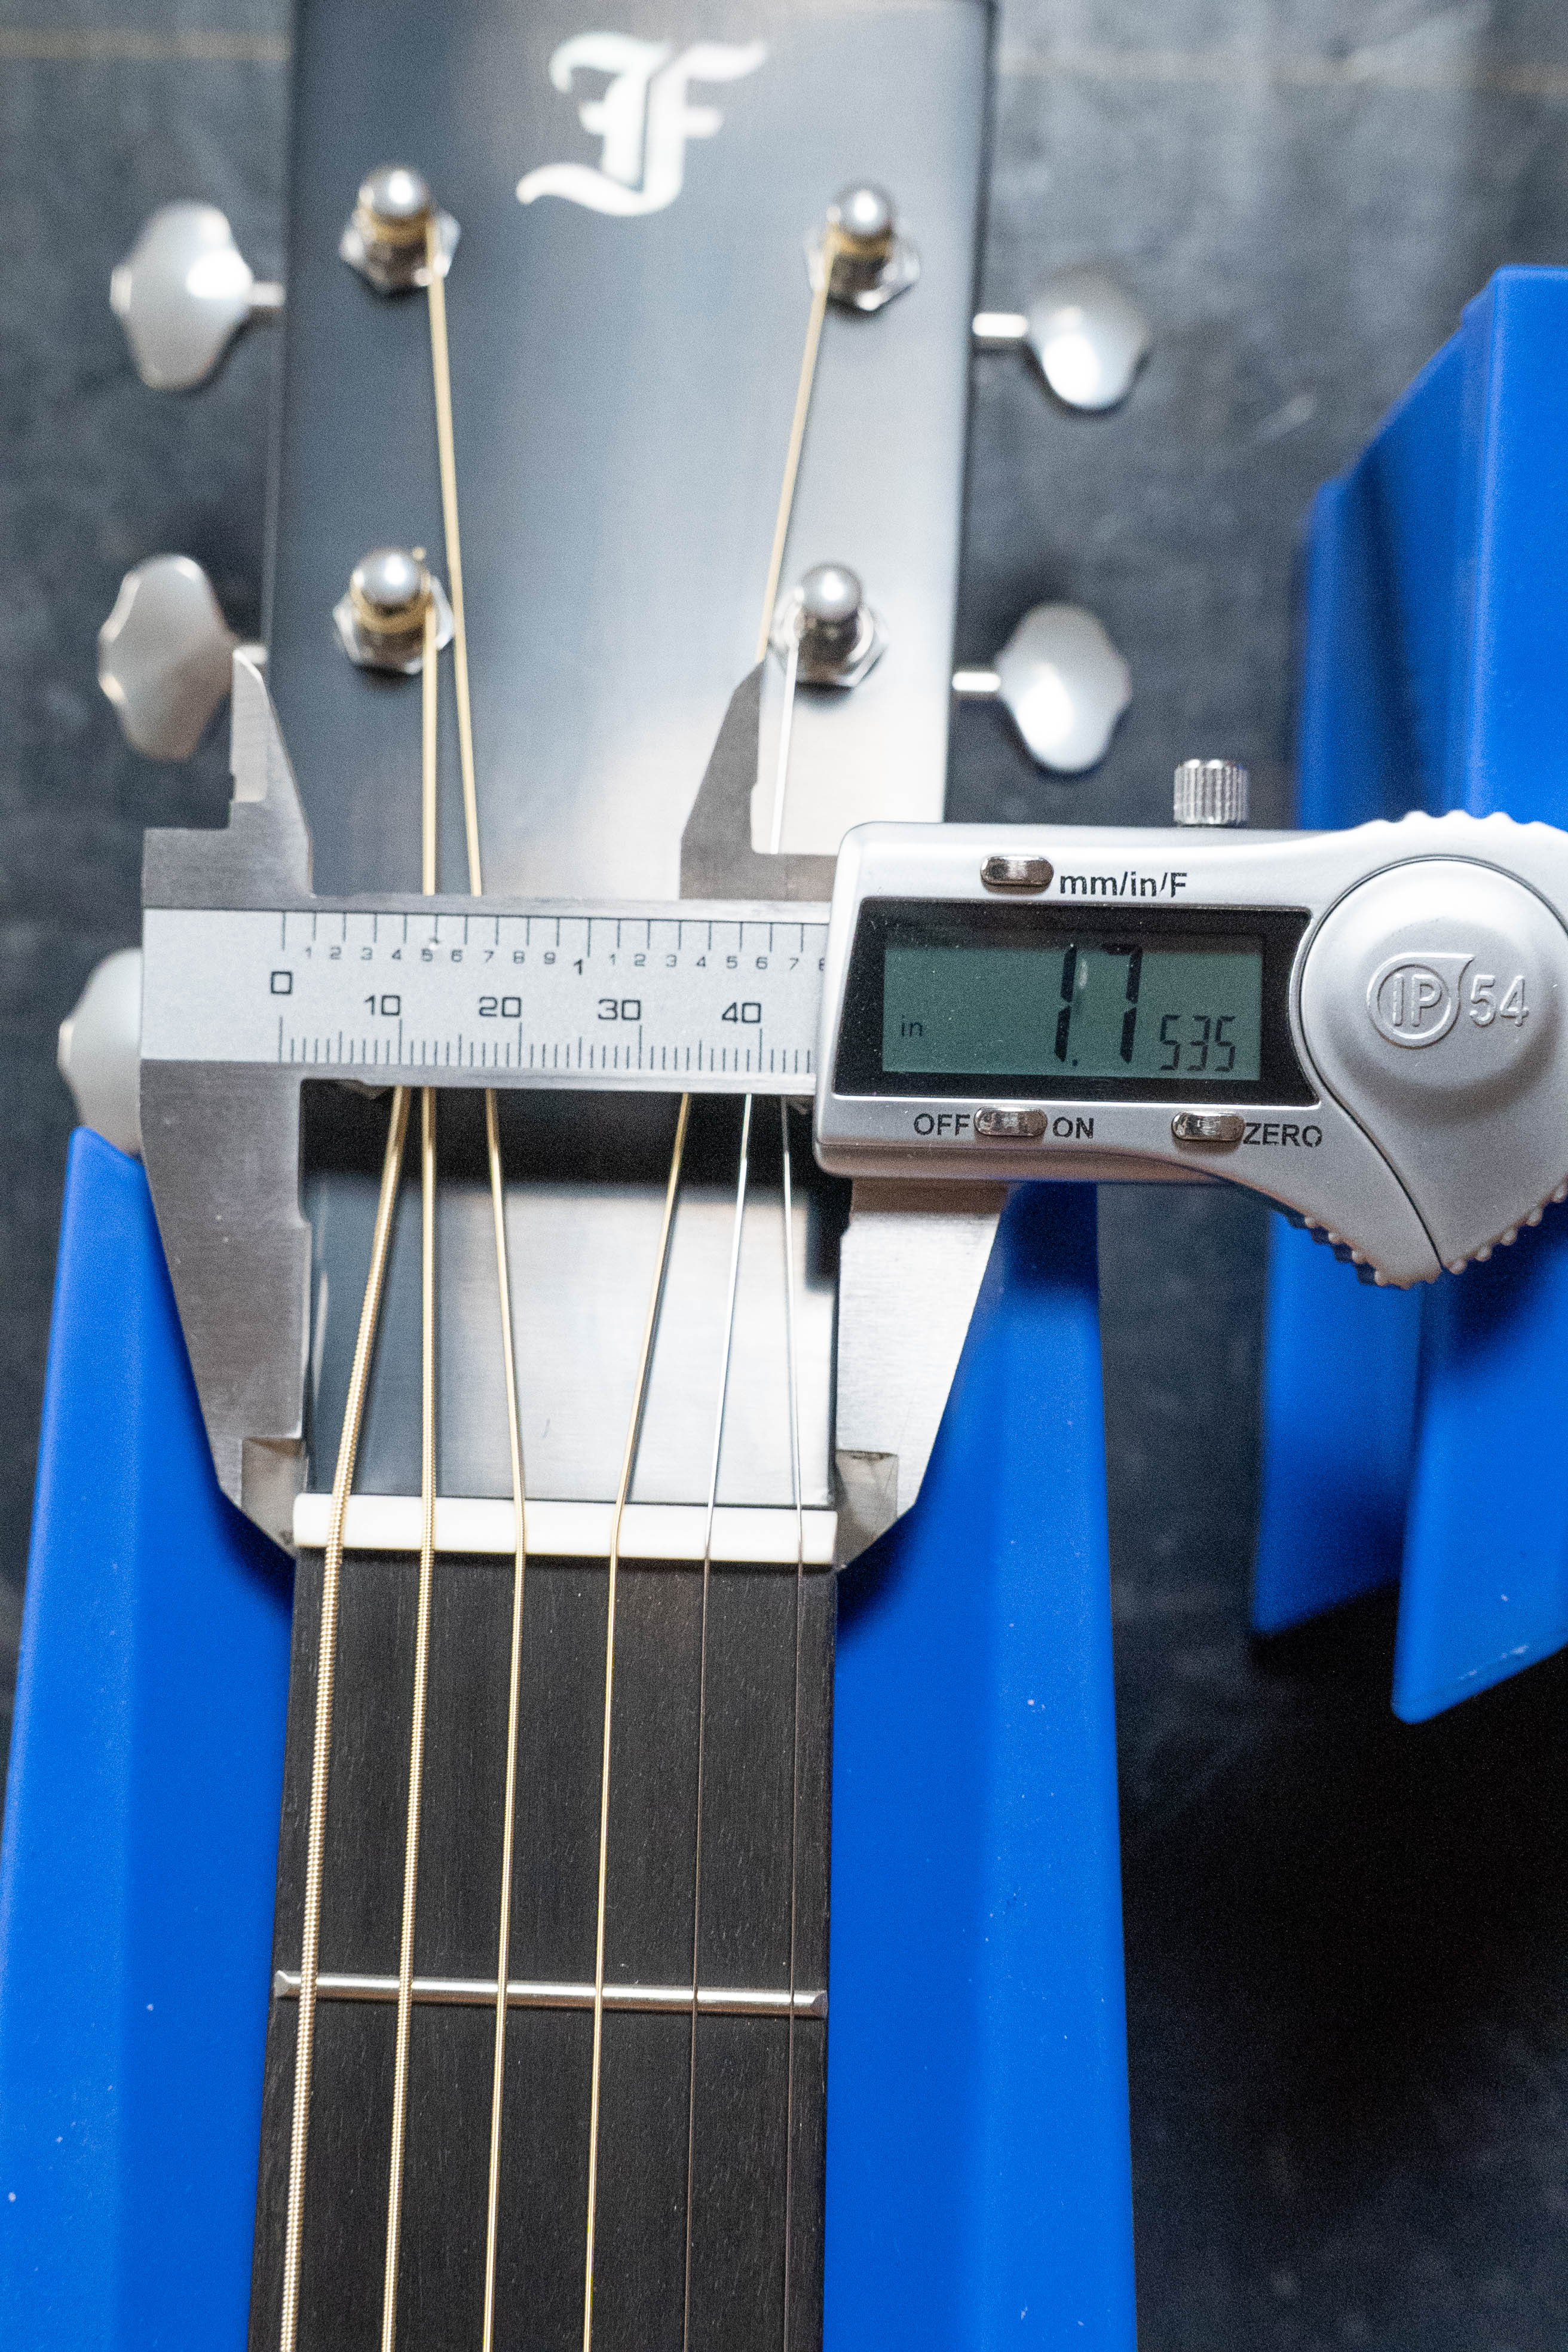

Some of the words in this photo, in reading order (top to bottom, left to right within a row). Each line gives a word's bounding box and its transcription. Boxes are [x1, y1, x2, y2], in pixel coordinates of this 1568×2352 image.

[1060, 871, 1187, 898] mm/in/F
[305, 947, 312, 957] 1
[329, 946, 342, 960] 2
[360, 947, 373, 961] 3
[391, 949, 402, 960] 4
[421, 948, 433, 962] 5
[451, 949, 463, 963] 6
[484, 950, 495, 963] 7
[513, 951, 525, 964] 8
[543, 951, 556, 965] 9
[574, 958, 583, 975] 1
[610, 953, 616, 965] 1
[633, 953, 647, 967] 2
[666, 954, 678, 968] 3
[696, 956, 706, 967] 4
[726, 956, 738, 969] 5
[755, 956, 768, 970] 6
[789, 957, 800, 970] 7
[270, 970, 293, 996] 0
[365, 994, 401, 1016] 10
[479, 996, 522, 1018] 20
[598, 999, 641, 1021] 30
[721, 1002, 762, 1024] 40
[1393, 973, 1443, 1027] IP
[1469, 974, 1529, 1027] 54
[901, 1014, 924, 1037] in
[913, 1113, 971, 1136] OFF
[1052, 1116, 1094, 1140] ON
[1242, 1122, 1323, 1148] ZERO
